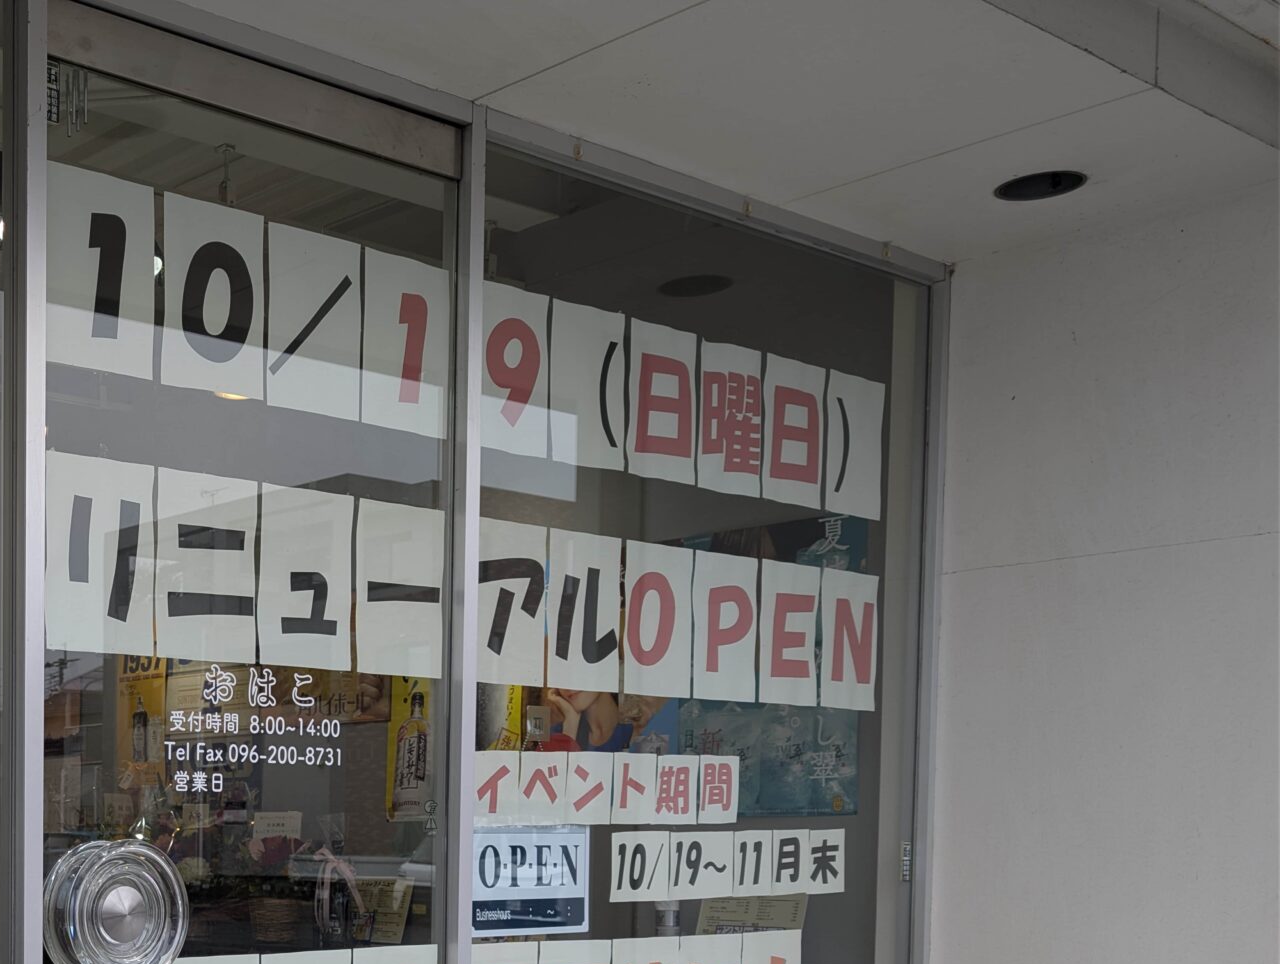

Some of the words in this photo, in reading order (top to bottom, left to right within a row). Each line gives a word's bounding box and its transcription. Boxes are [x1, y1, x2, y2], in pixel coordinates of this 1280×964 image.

[69, 494, 874, 684] リニューアルOPEN
[204, 664, 316, 708] おはこ
[170, 711, 239, 734] 受付時間
[249, 716, 341, 738] 8:00~14:00
[164, 741, 190, 761] Tel
[196, 743, 223, 762] Fax
[228, 744, 343, 767] 096-200-8731
[174, 770, 224, 793] 営業日
[477, 763, 734, 815] イベント期間
